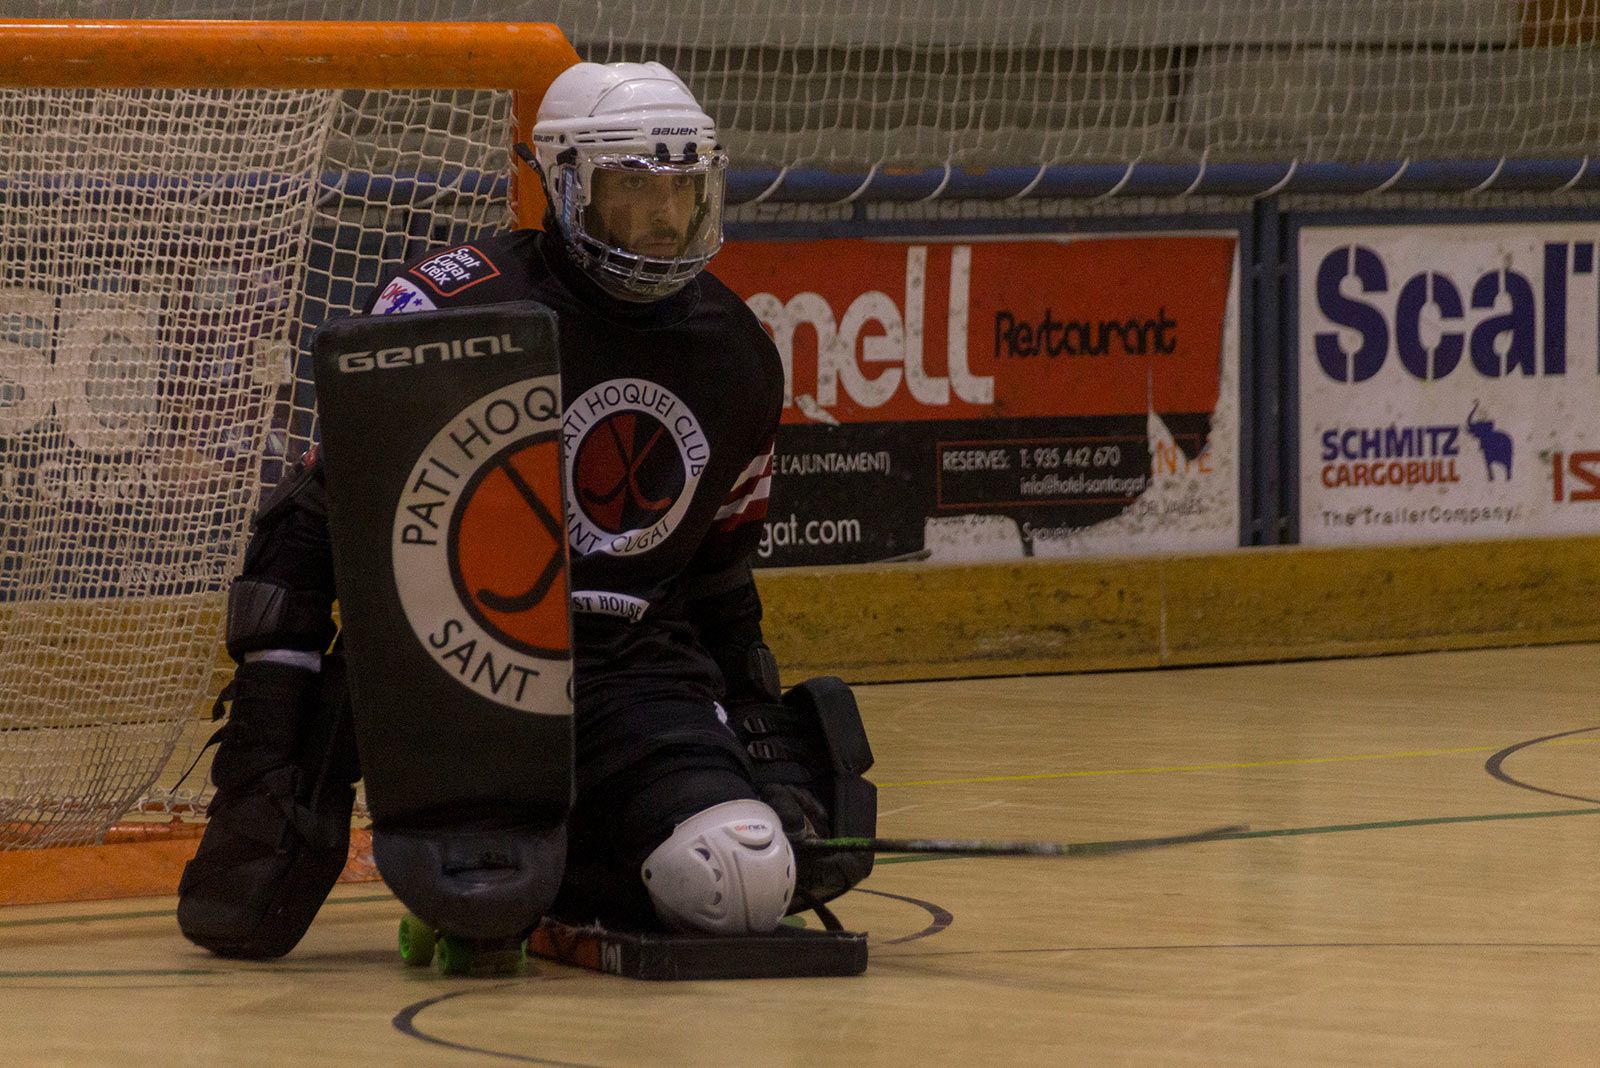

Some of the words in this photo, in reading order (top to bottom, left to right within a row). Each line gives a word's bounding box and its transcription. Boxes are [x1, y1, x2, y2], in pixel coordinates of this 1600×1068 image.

[420, 259, 452, 286] Creix
[434, 252, 471, 281] Cugat
[455, 248, 481, 268] Sant
[1314, 240, 1600, 384] Scal'
[993, 304, 1178, 359] Restaurant
[562, 408, 588, 460] ATI
[584, 383, 676, 419] HOQUEI
[674, 415, 707, 478] CLUB
[1321, 424, 1462, 462] SCHMITZ
[942, 450, 1011, 472] RESERVES:
[1033, 447, 1061, 469] 935
[1062, 446, 1091, 468] 442
[1092, 445, 1122, 467] 670
[1321, 459, 1461, 489] CARGOBULL
[401, 457, 461, 546] PATI
[611, 515, 670, 553] CUGAT
[429, 608, 540, 702] SANT
